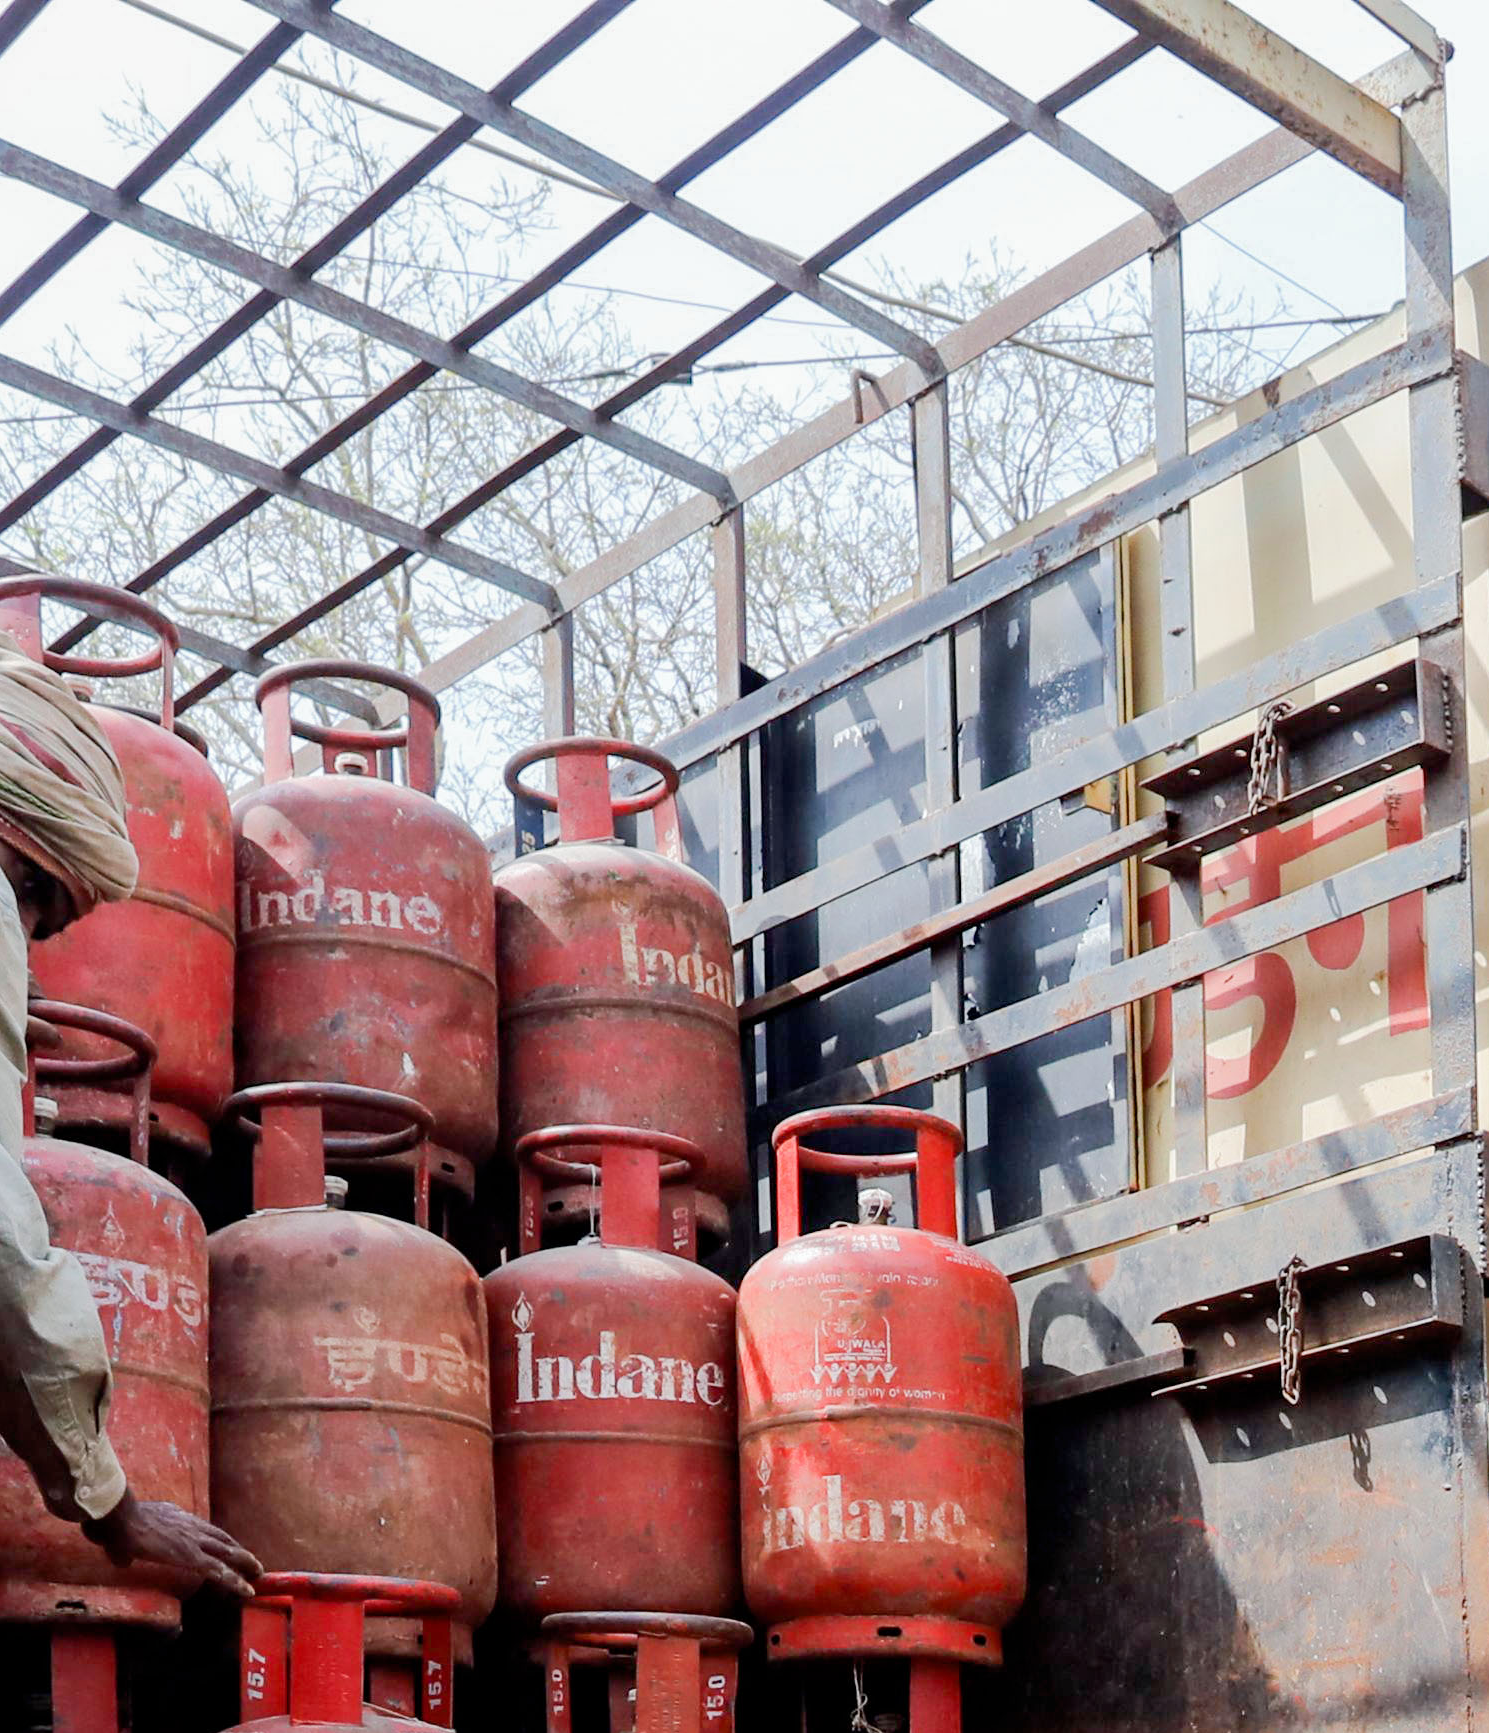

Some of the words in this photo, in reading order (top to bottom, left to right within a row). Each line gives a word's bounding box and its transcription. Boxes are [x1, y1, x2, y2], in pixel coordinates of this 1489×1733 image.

[241, 868, 442, 934] Indane
[672, 1206, 689, 1250] 15.0
[513, 1330, 725, 1406] Indane
[759, 1474, 967, 1552] Indane
[247, 1648, 267, 1701] 15.7
[427, 1659, 442, 1711] 15.7
[551, 1668, 565, 1716] 15.0
[704, 1674, 727, 1721] 15.0
